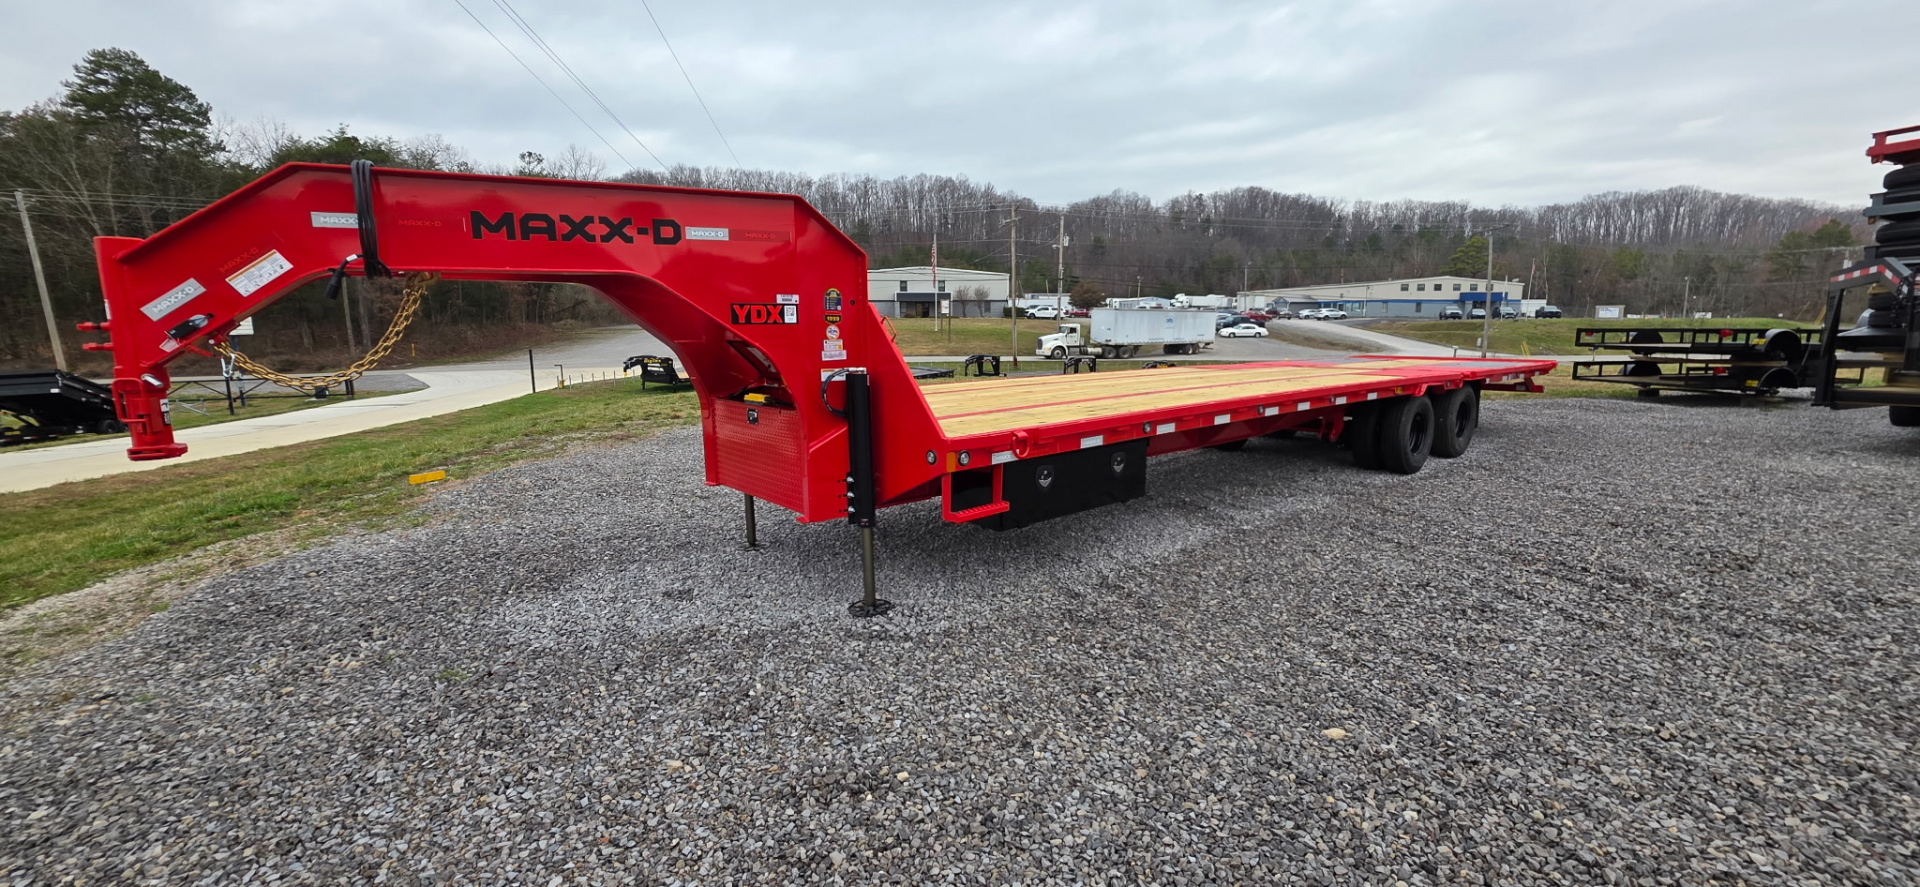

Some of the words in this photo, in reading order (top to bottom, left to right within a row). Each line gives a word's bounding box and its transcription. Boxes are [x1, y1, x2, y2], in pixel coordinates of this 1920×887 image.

[319, 216, 359, 225] MAXX-
[398, 219, 442, 227] MAXX-D
[471, 211, 683, 246] MAXX-D
[691, 230, 724, 238] MAXX-D
[152, 286, 195, 314] MAXX-D
[733, 305, 783, 323] YDX
